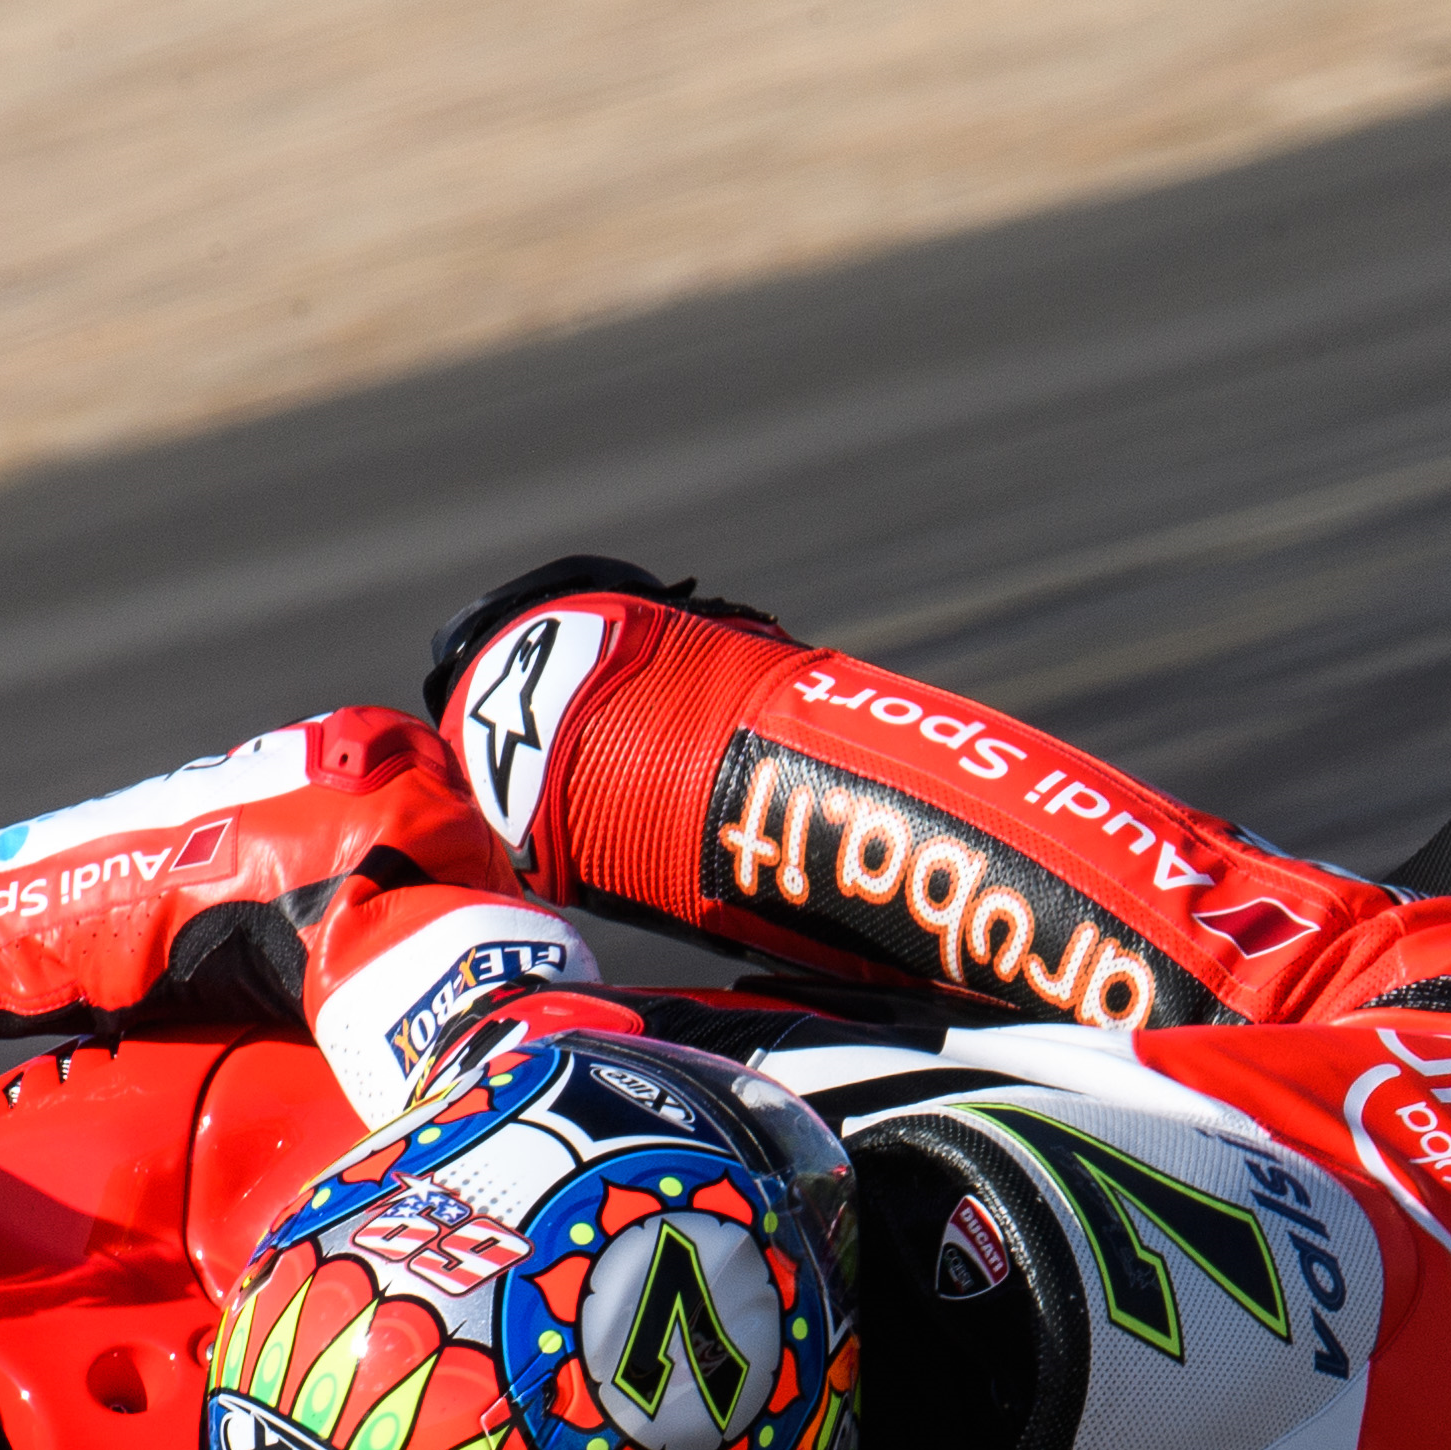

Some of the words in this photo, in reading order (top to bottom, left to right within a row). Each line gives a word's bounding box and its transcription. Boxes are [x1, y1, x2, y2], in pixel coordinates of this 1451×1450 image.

[793, 669, 1028, 780] Sport
[61, 846, 172, 905] Audi
[1024, 769, 1216, 893] Audi
[718, 755, 1158, 1031] aruba.it
[350, 1190, 535, 1298] 69
[949, 1102, 1292, 1366] 7
[959, 1206, 1005, 1273] DUCATI
[613, 1221, 750, 1434] 7
